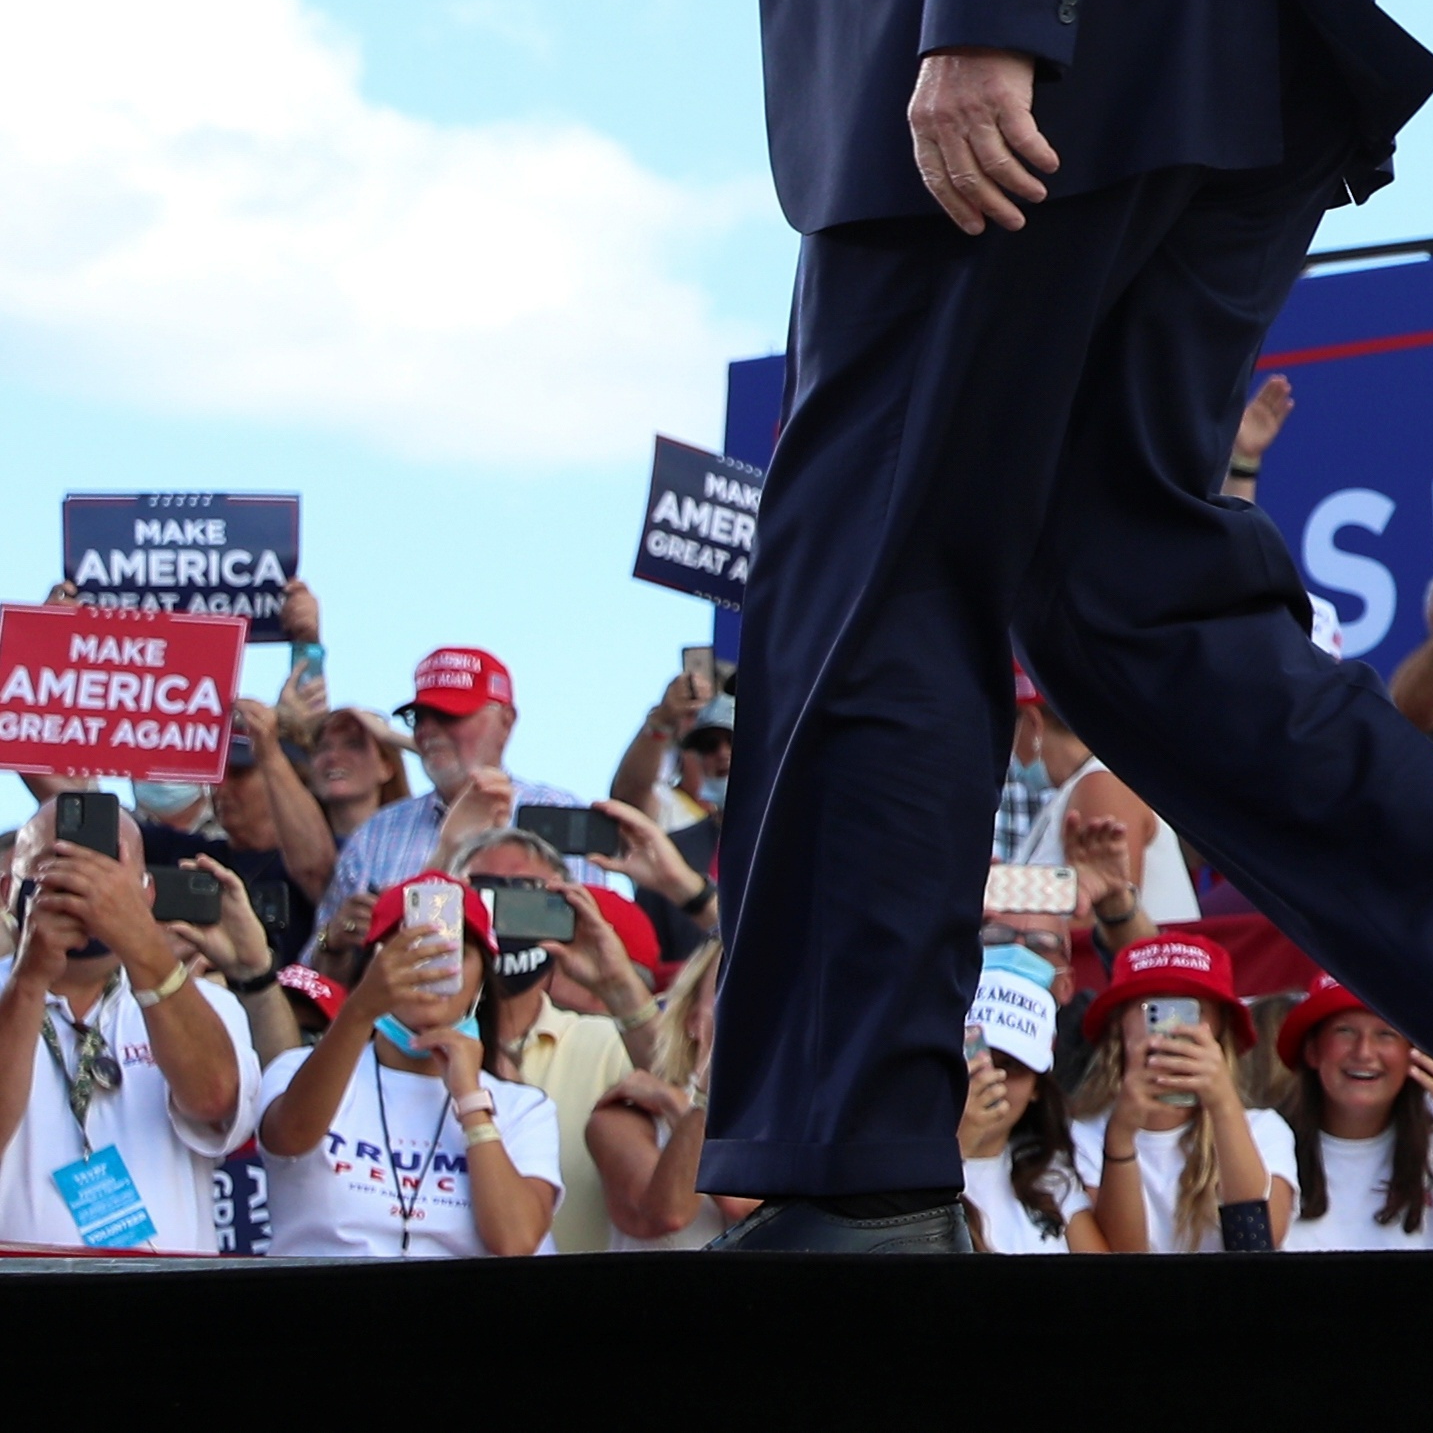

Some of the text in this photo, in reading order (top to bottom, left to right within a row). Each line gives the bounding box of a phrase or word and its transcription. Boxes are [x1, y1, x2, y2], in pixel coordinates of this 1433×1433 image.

[704, 471, 763, 514] MAK
[134, 518, 228, 546] MAKE
[651, 490, 757, 552] AMER
[74, 548, 289, 588] AMERICA
[646, 529, 732, 576] GREAT
[187, 592, 287, 618] AGAIN
[69, 632, 168, 667] MAKE
[0, 664, 223, 717] AMERICA
[0, 711, 221, 753] GREAT AGAIN
[966, 1007, 1038, 1039] EAT AGAIN
[987, 986, 1048, 1021] AMERICA
[326, 1128, 468, 1174] TRUM
[333, 1160, 456, 1193] PENC
[212, 1169, 237, 1252] GRE
